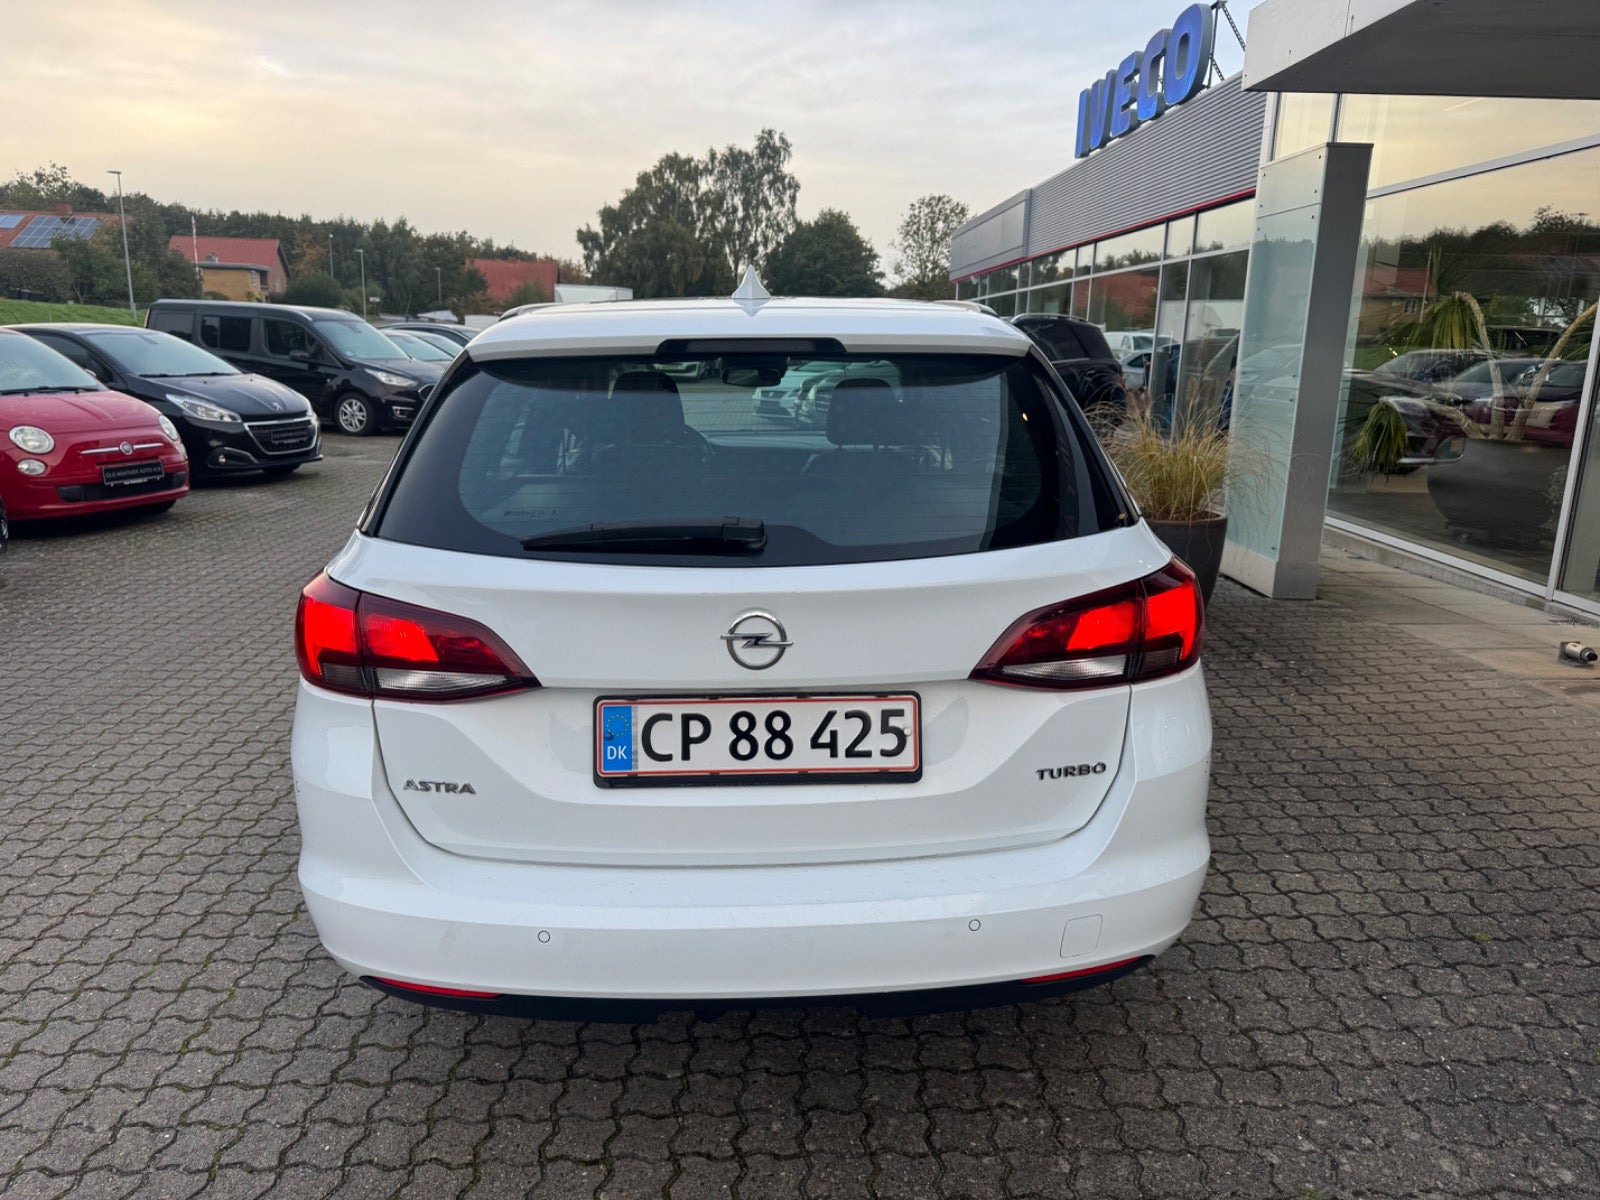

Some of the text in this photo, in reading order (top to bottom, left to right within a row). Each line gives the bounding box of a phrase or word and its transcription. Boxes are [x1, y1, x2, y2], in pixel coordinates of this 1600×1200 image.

[1075, 3, 1213, 158] IVECO
[641, 708, 908, 762] CP 88 425
[607, 745, 628, 760] DK
[1036, 762, 1107, 780] TURBO
[403, 779, 476, 795] ASTRA
